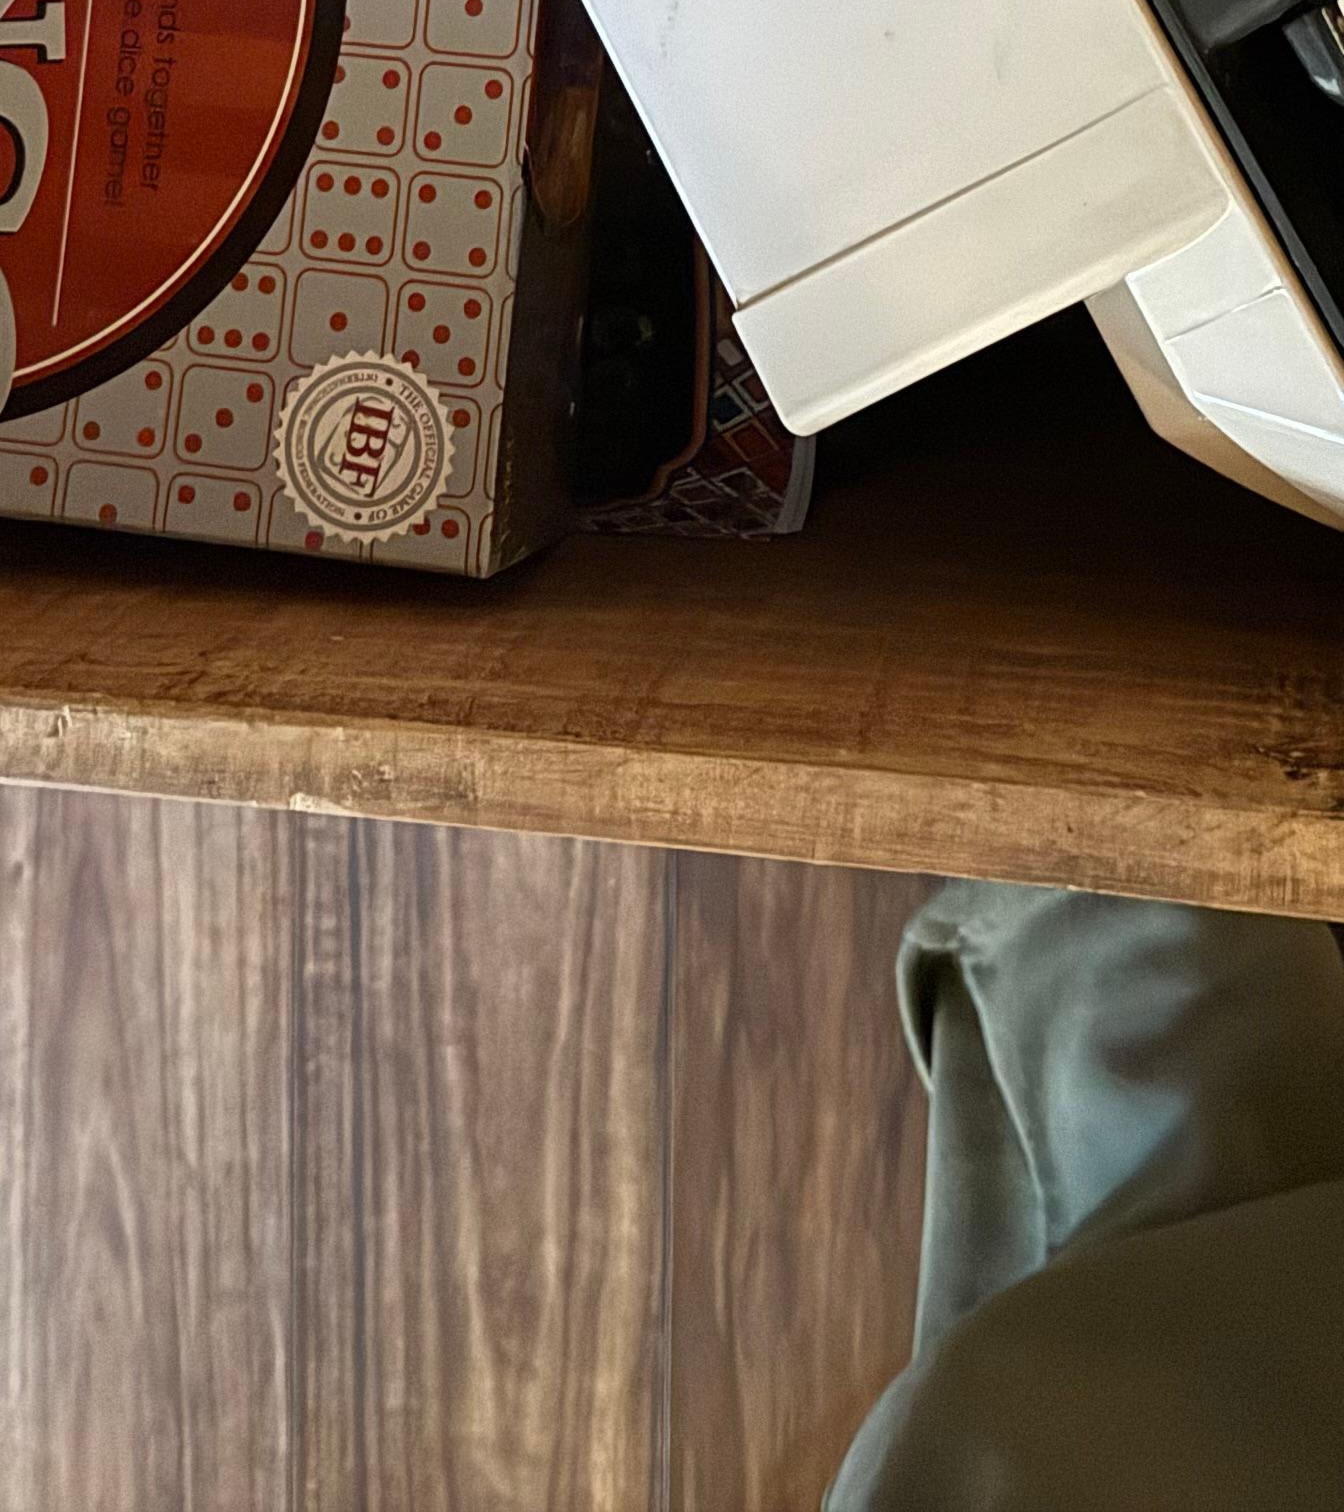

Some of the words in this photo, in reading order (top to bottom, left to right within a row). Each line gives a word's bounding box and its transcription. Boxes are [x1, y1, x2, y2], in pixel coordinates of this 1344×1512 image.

[113, 27, 143, 97] dice
[140, 55, 177, 191] together
[397, 383, 423, 414] THE
[339, 395, 396, 499] IBF
[417, 410, 438, 481] OFFICIAL
[367, 508, 388, 524] OF
[391, 482, 424, 513] GAME
